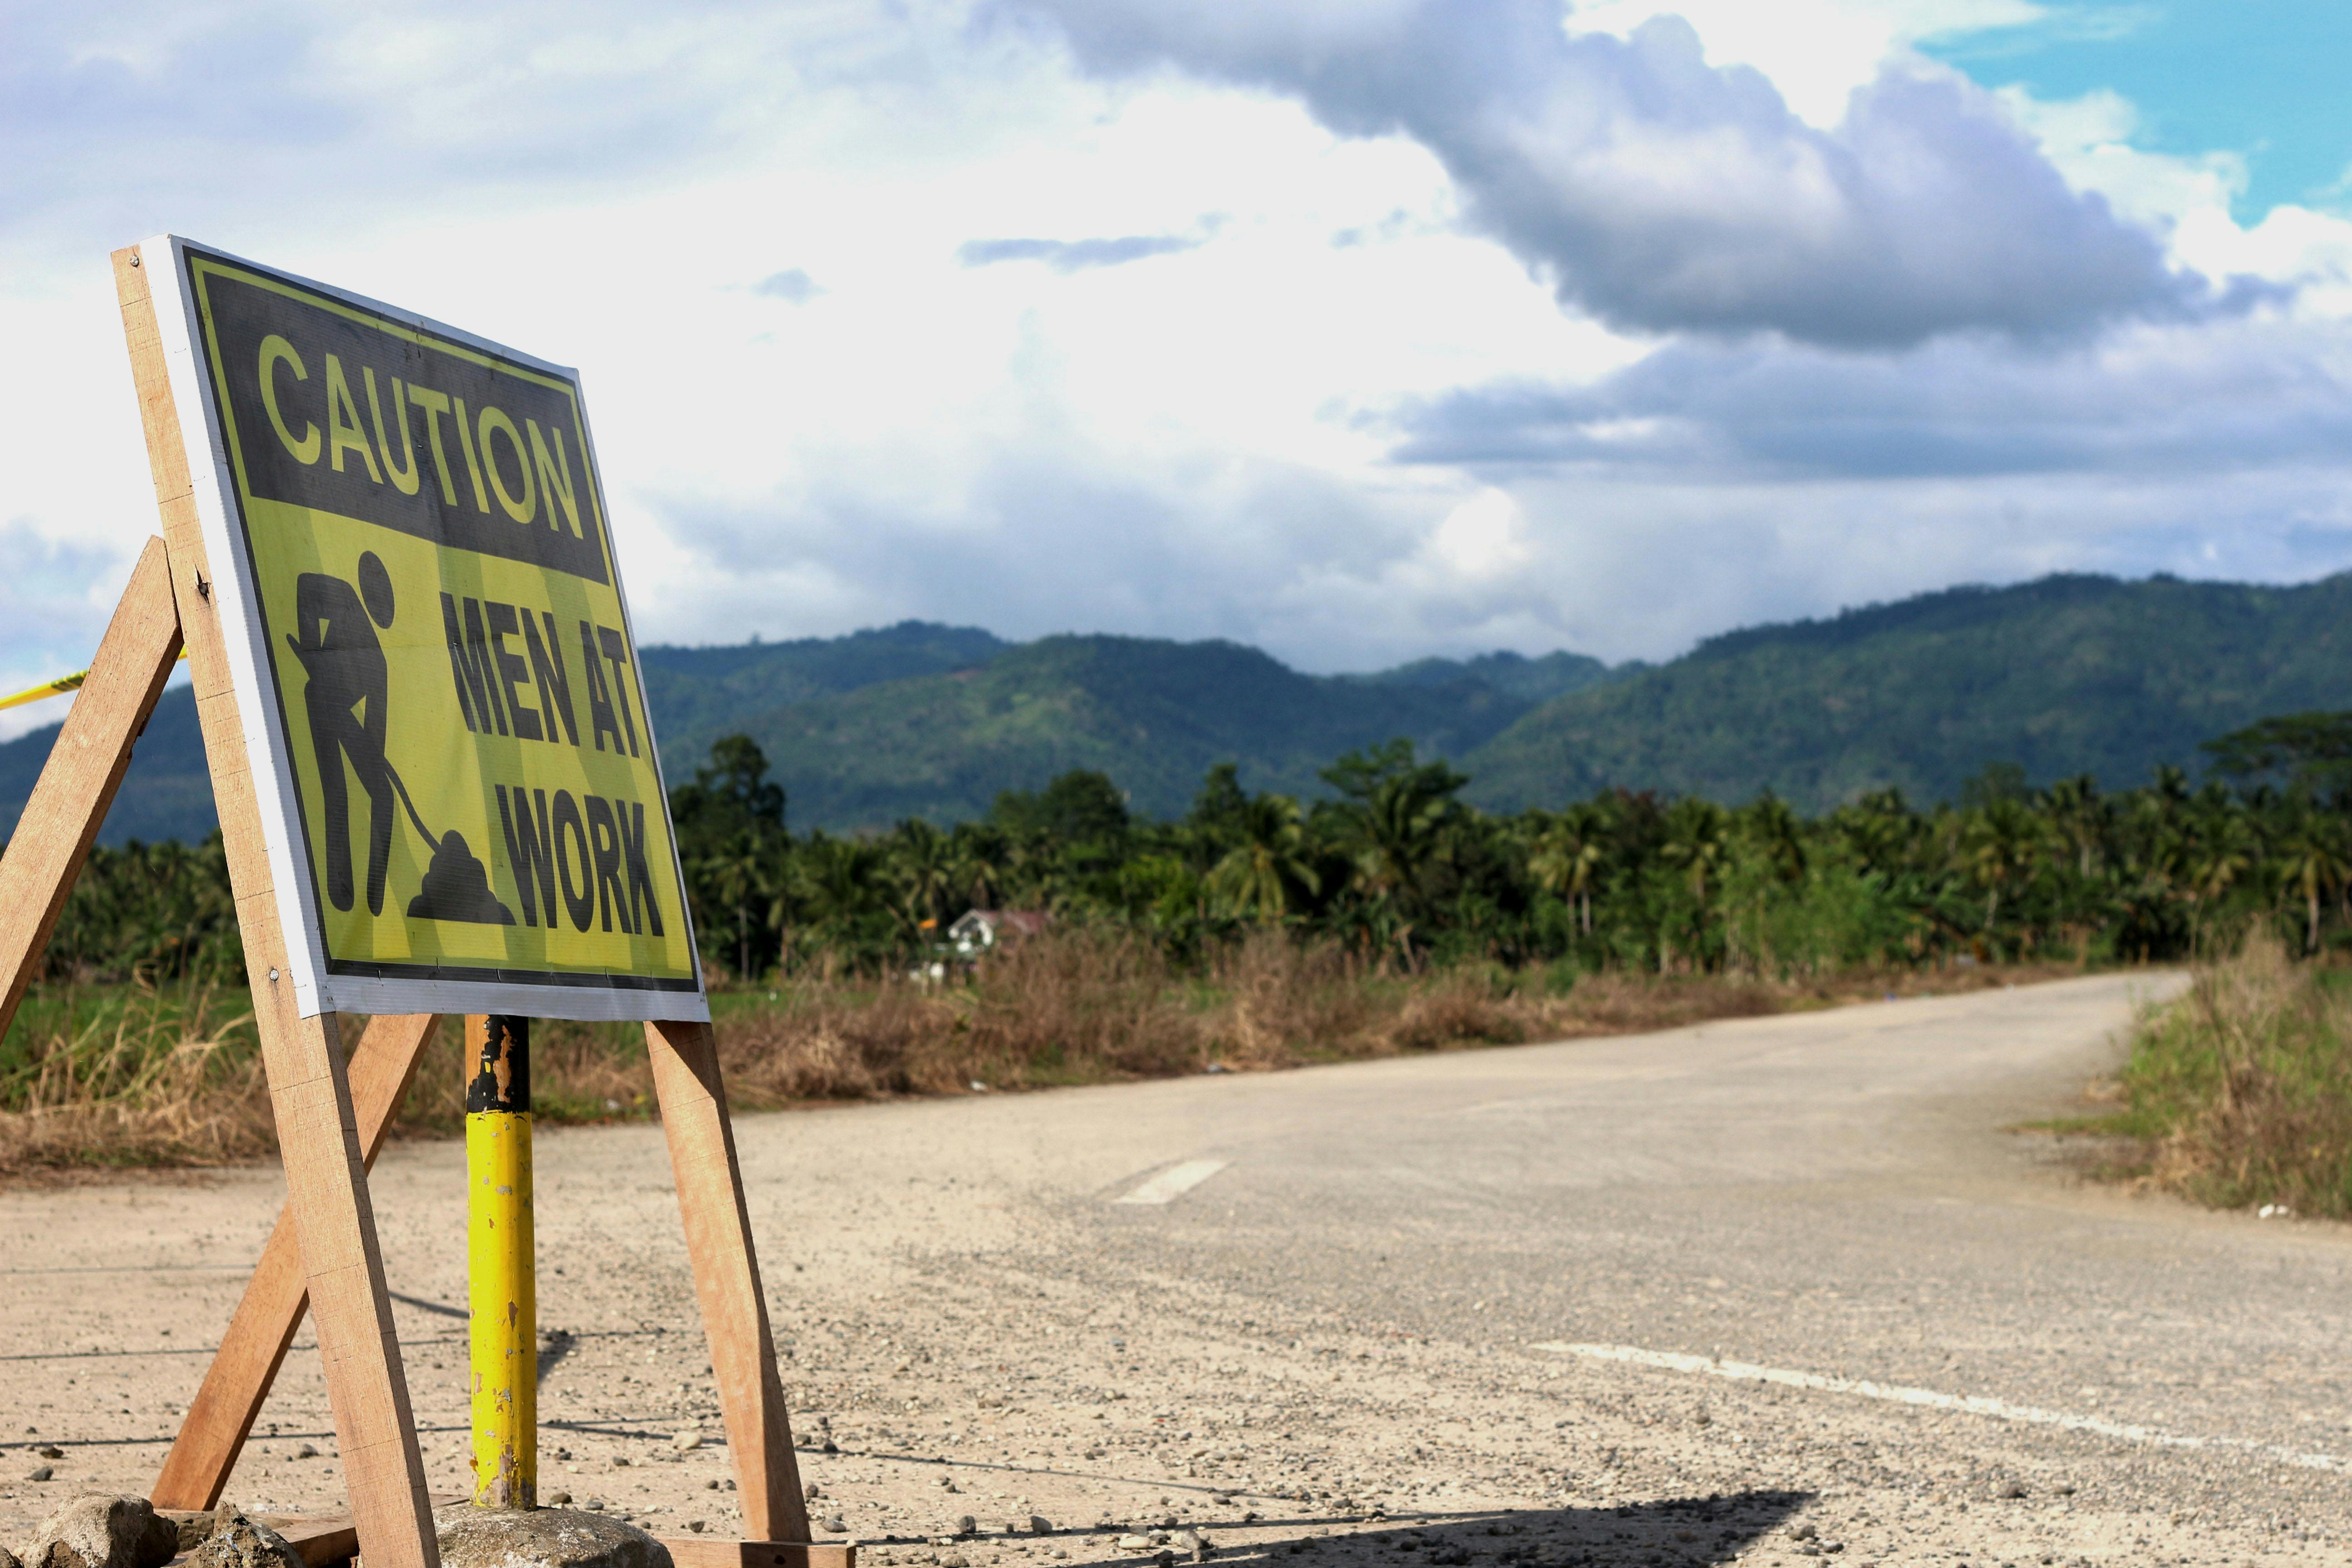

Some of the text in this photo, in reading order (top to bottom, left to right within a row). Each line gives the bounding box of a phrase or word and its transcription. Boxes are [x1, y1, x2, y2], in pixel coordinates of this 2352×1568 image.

[259, 334, 583, 539] CAUTION
[440, 592, 640, 758] MEN AT
[495, 784, 665, 937] WORK
